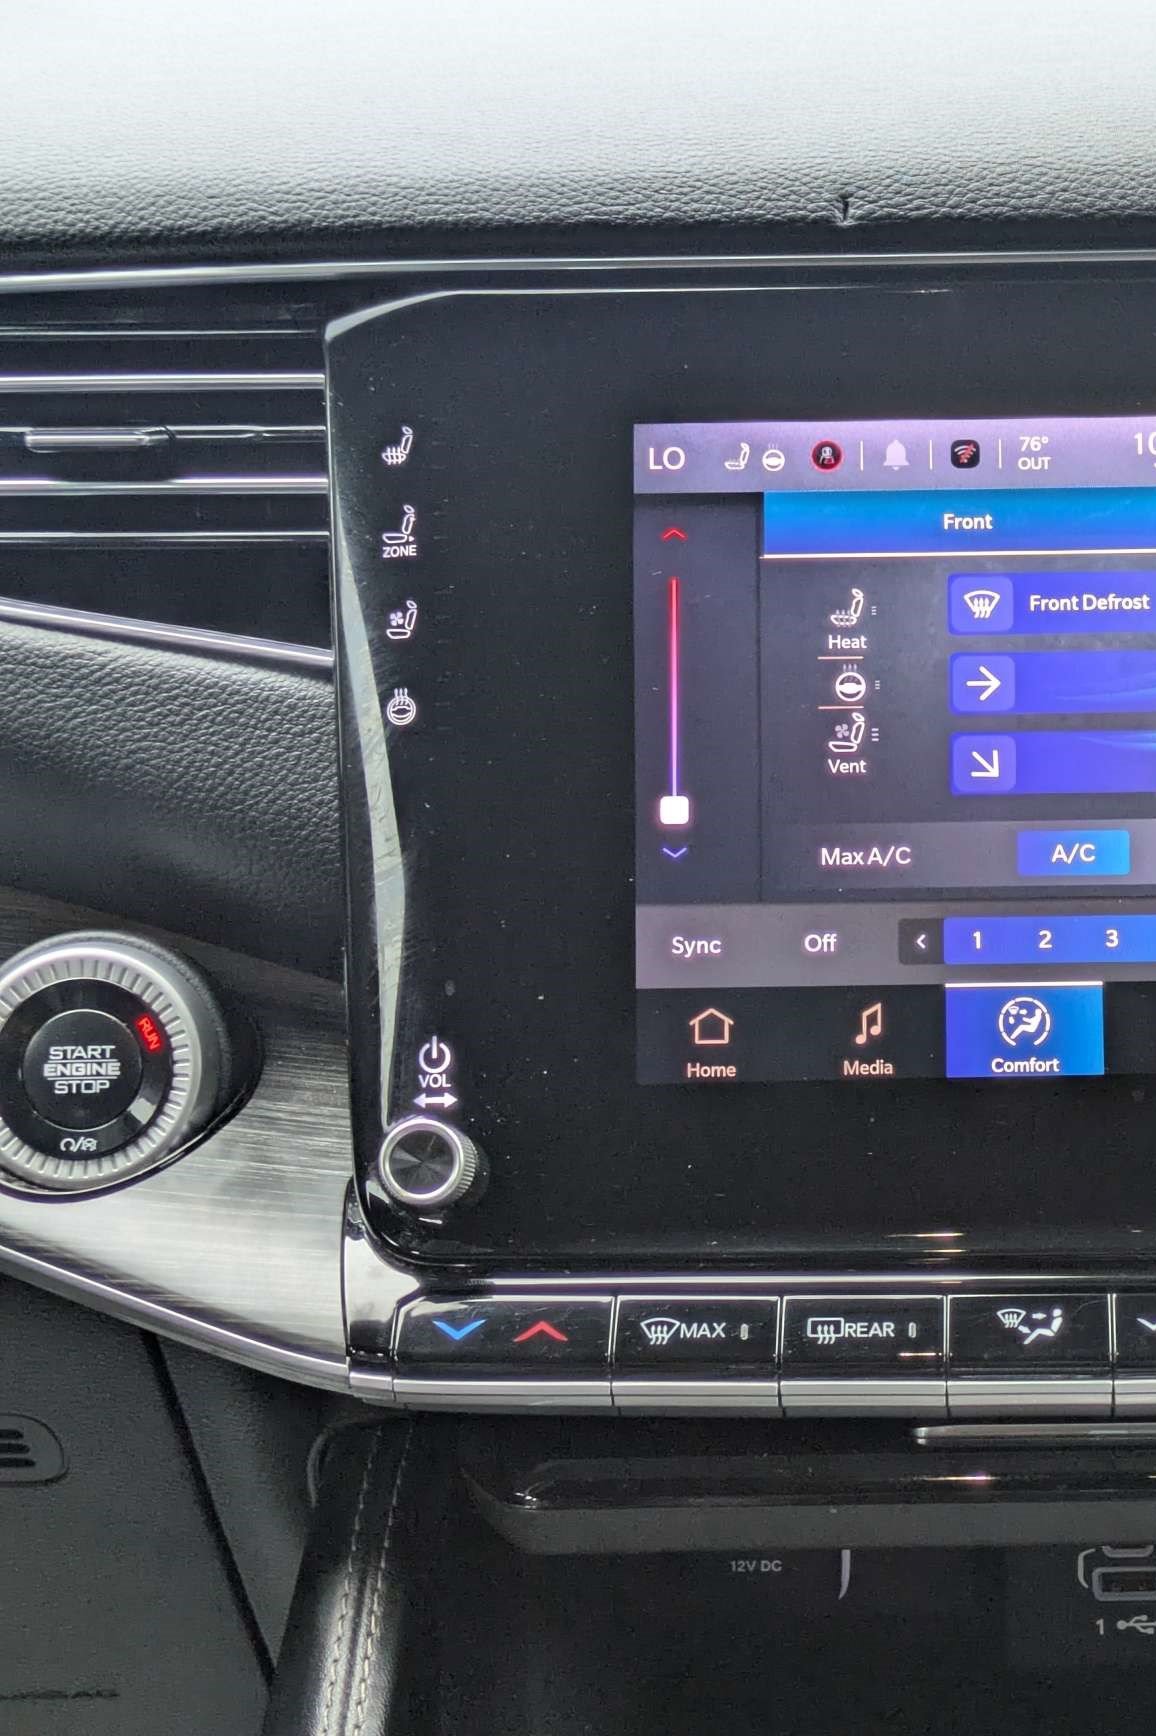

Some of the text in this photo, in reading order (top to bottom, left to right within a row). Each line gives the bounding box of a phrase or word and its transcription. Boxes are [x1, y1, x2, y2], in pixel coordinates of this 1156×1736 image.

[1018, 435, 1049, 452] 76°
[648, 446, 686, 471] LO
[1017, 456, 1052, 471] OUT
[943, 513, 993, 530] Front
[382, 544, 417, 559] ZONE
[1029, 593, 1151, 612] Front Defrost
[828, 634, 868, 650] Heat
[827, 758, 867, 774] Vent
[821, 845, 912, 867] Max A/C
[1051, 843, 1095, 865] A/C
[671, 936, 722, 959] Sync
[804, 933, 837, 953] Off
[973, 931, 981, 950] 1
[1038, 929, 1053, 949] 2
[1105, 929, 1119, 948] 3
[139, 1015, 161, 1051] RUN
[48, 1045, 117, 1060] START
[43, 1062, 121, 1076] ENGINE
[687, 1062, 737, 1078] Home
[843, 1059, 894, 1076] Media
[991, 1057, 1060, 1073] Comfort
[53, 1079, 111, 1095] STOP
[418, 1071, 452, 1088] VOL
[678, 1321, 727, 1339] MAX
[842, 1318, 895, 1338] REAR
[730, 1559, 783, 1572] 12V DC
[1095, 1618, 1105, 1635] 1
